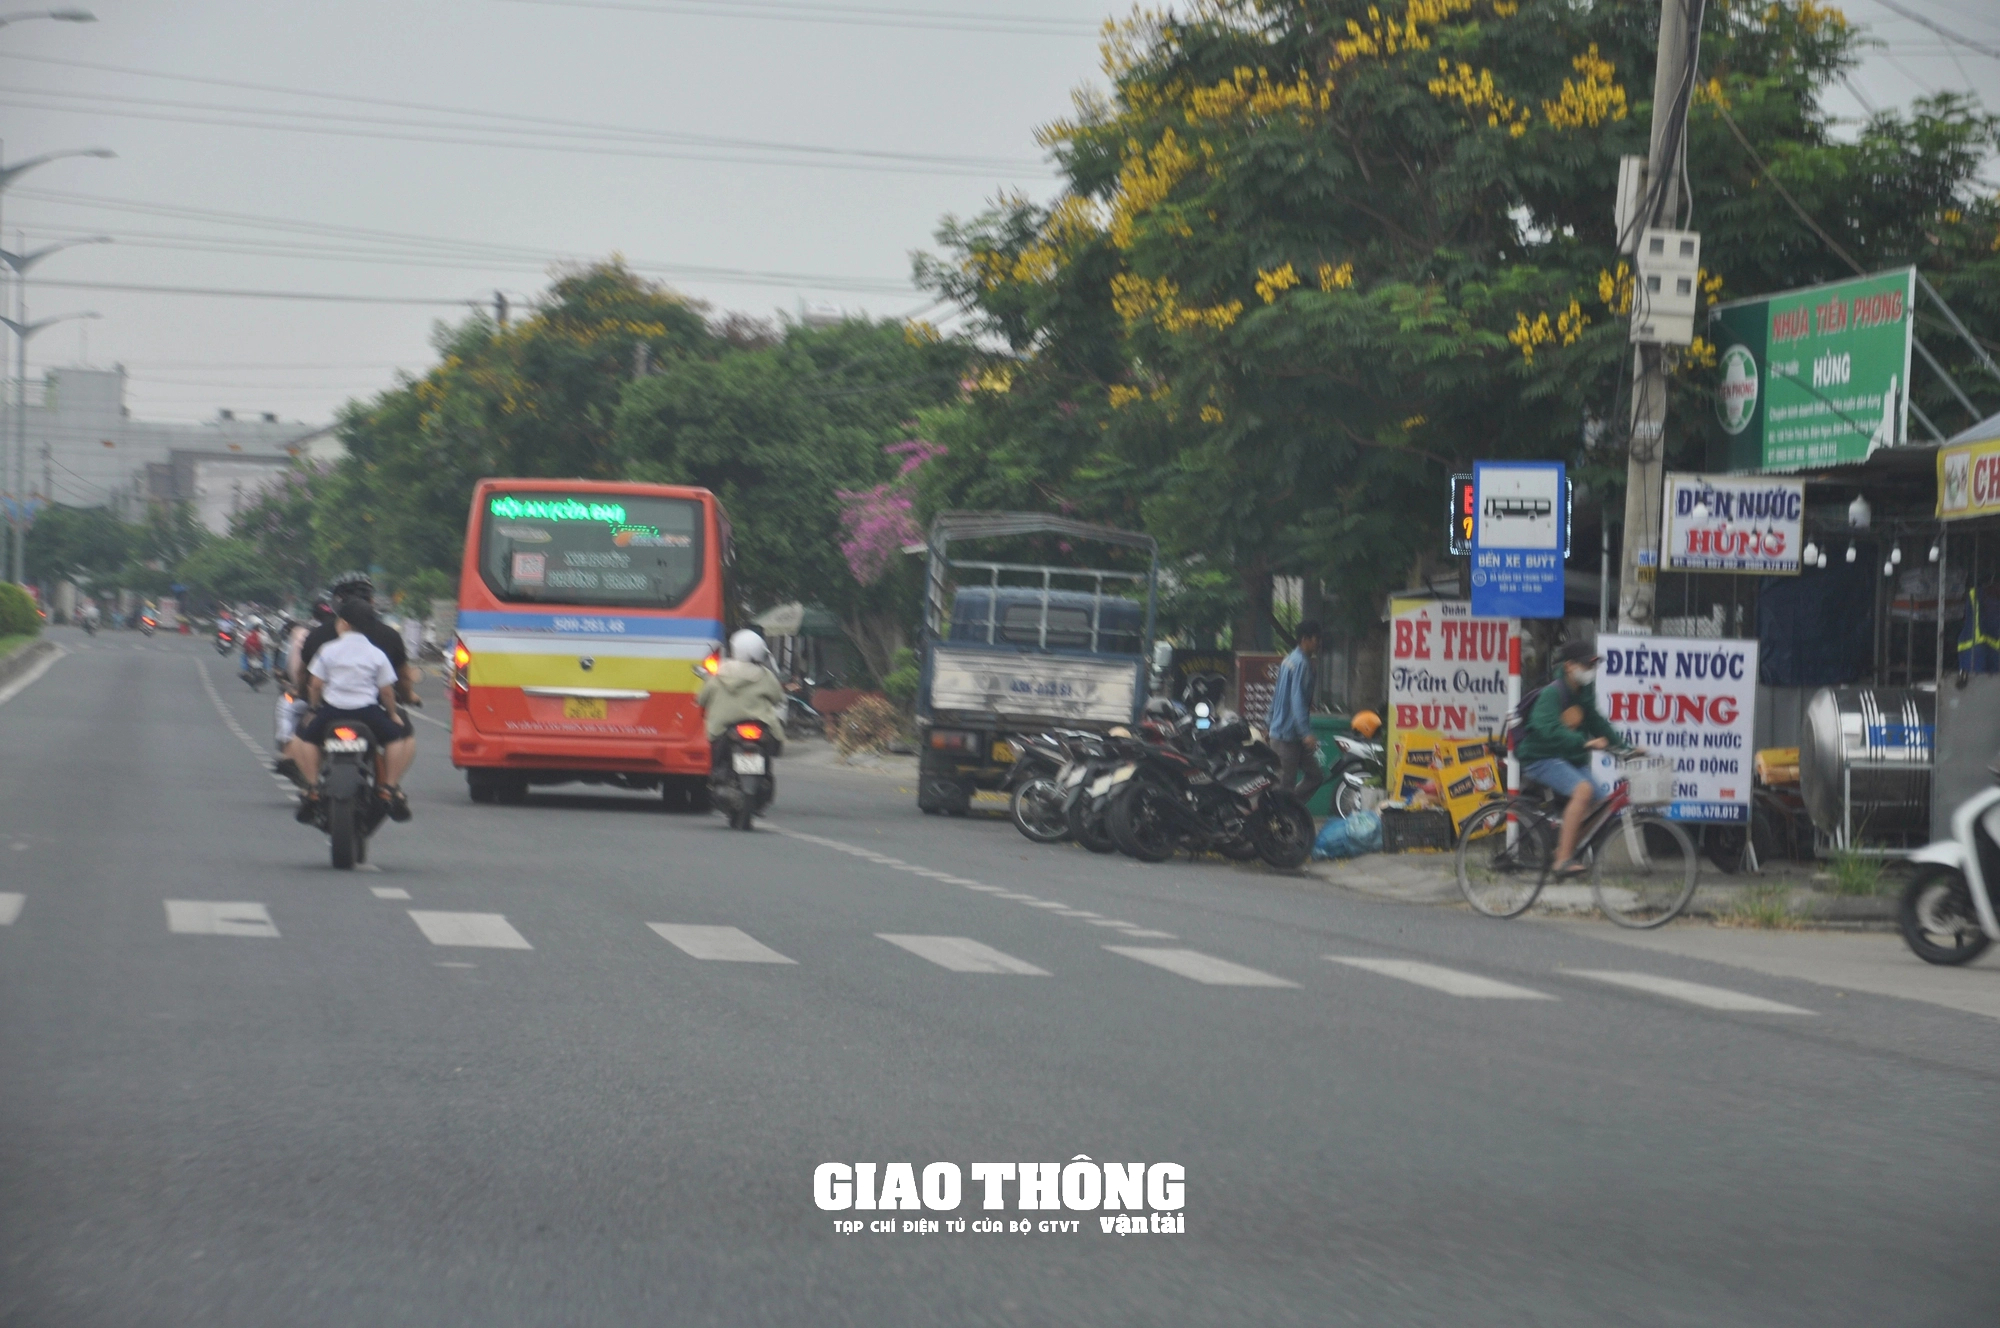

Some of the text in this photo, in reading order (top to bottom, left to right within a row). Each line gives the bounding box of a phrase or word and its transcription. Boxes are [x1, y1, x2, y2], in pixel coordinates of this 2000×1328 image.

[1853, 290, 1903, 330] PHONG
[1505, 554, 1520, 568] XE
[1395, 610, 1509, 662] BÊ THUI
[1606, 642, 1744, 684] ĐIỆN NƯỚC
[1453, 669, 1507, 695] Oanh
[1396, 698, 1467, 731] BÚN
[1608, 684, 1739, 725] HÙNG
[1666, 730, 1699, 750] ĐIỆN
[1703, 730, 1742, 748] NƯỚC
[1699, 756, 1739, 777] ĐỘNG
